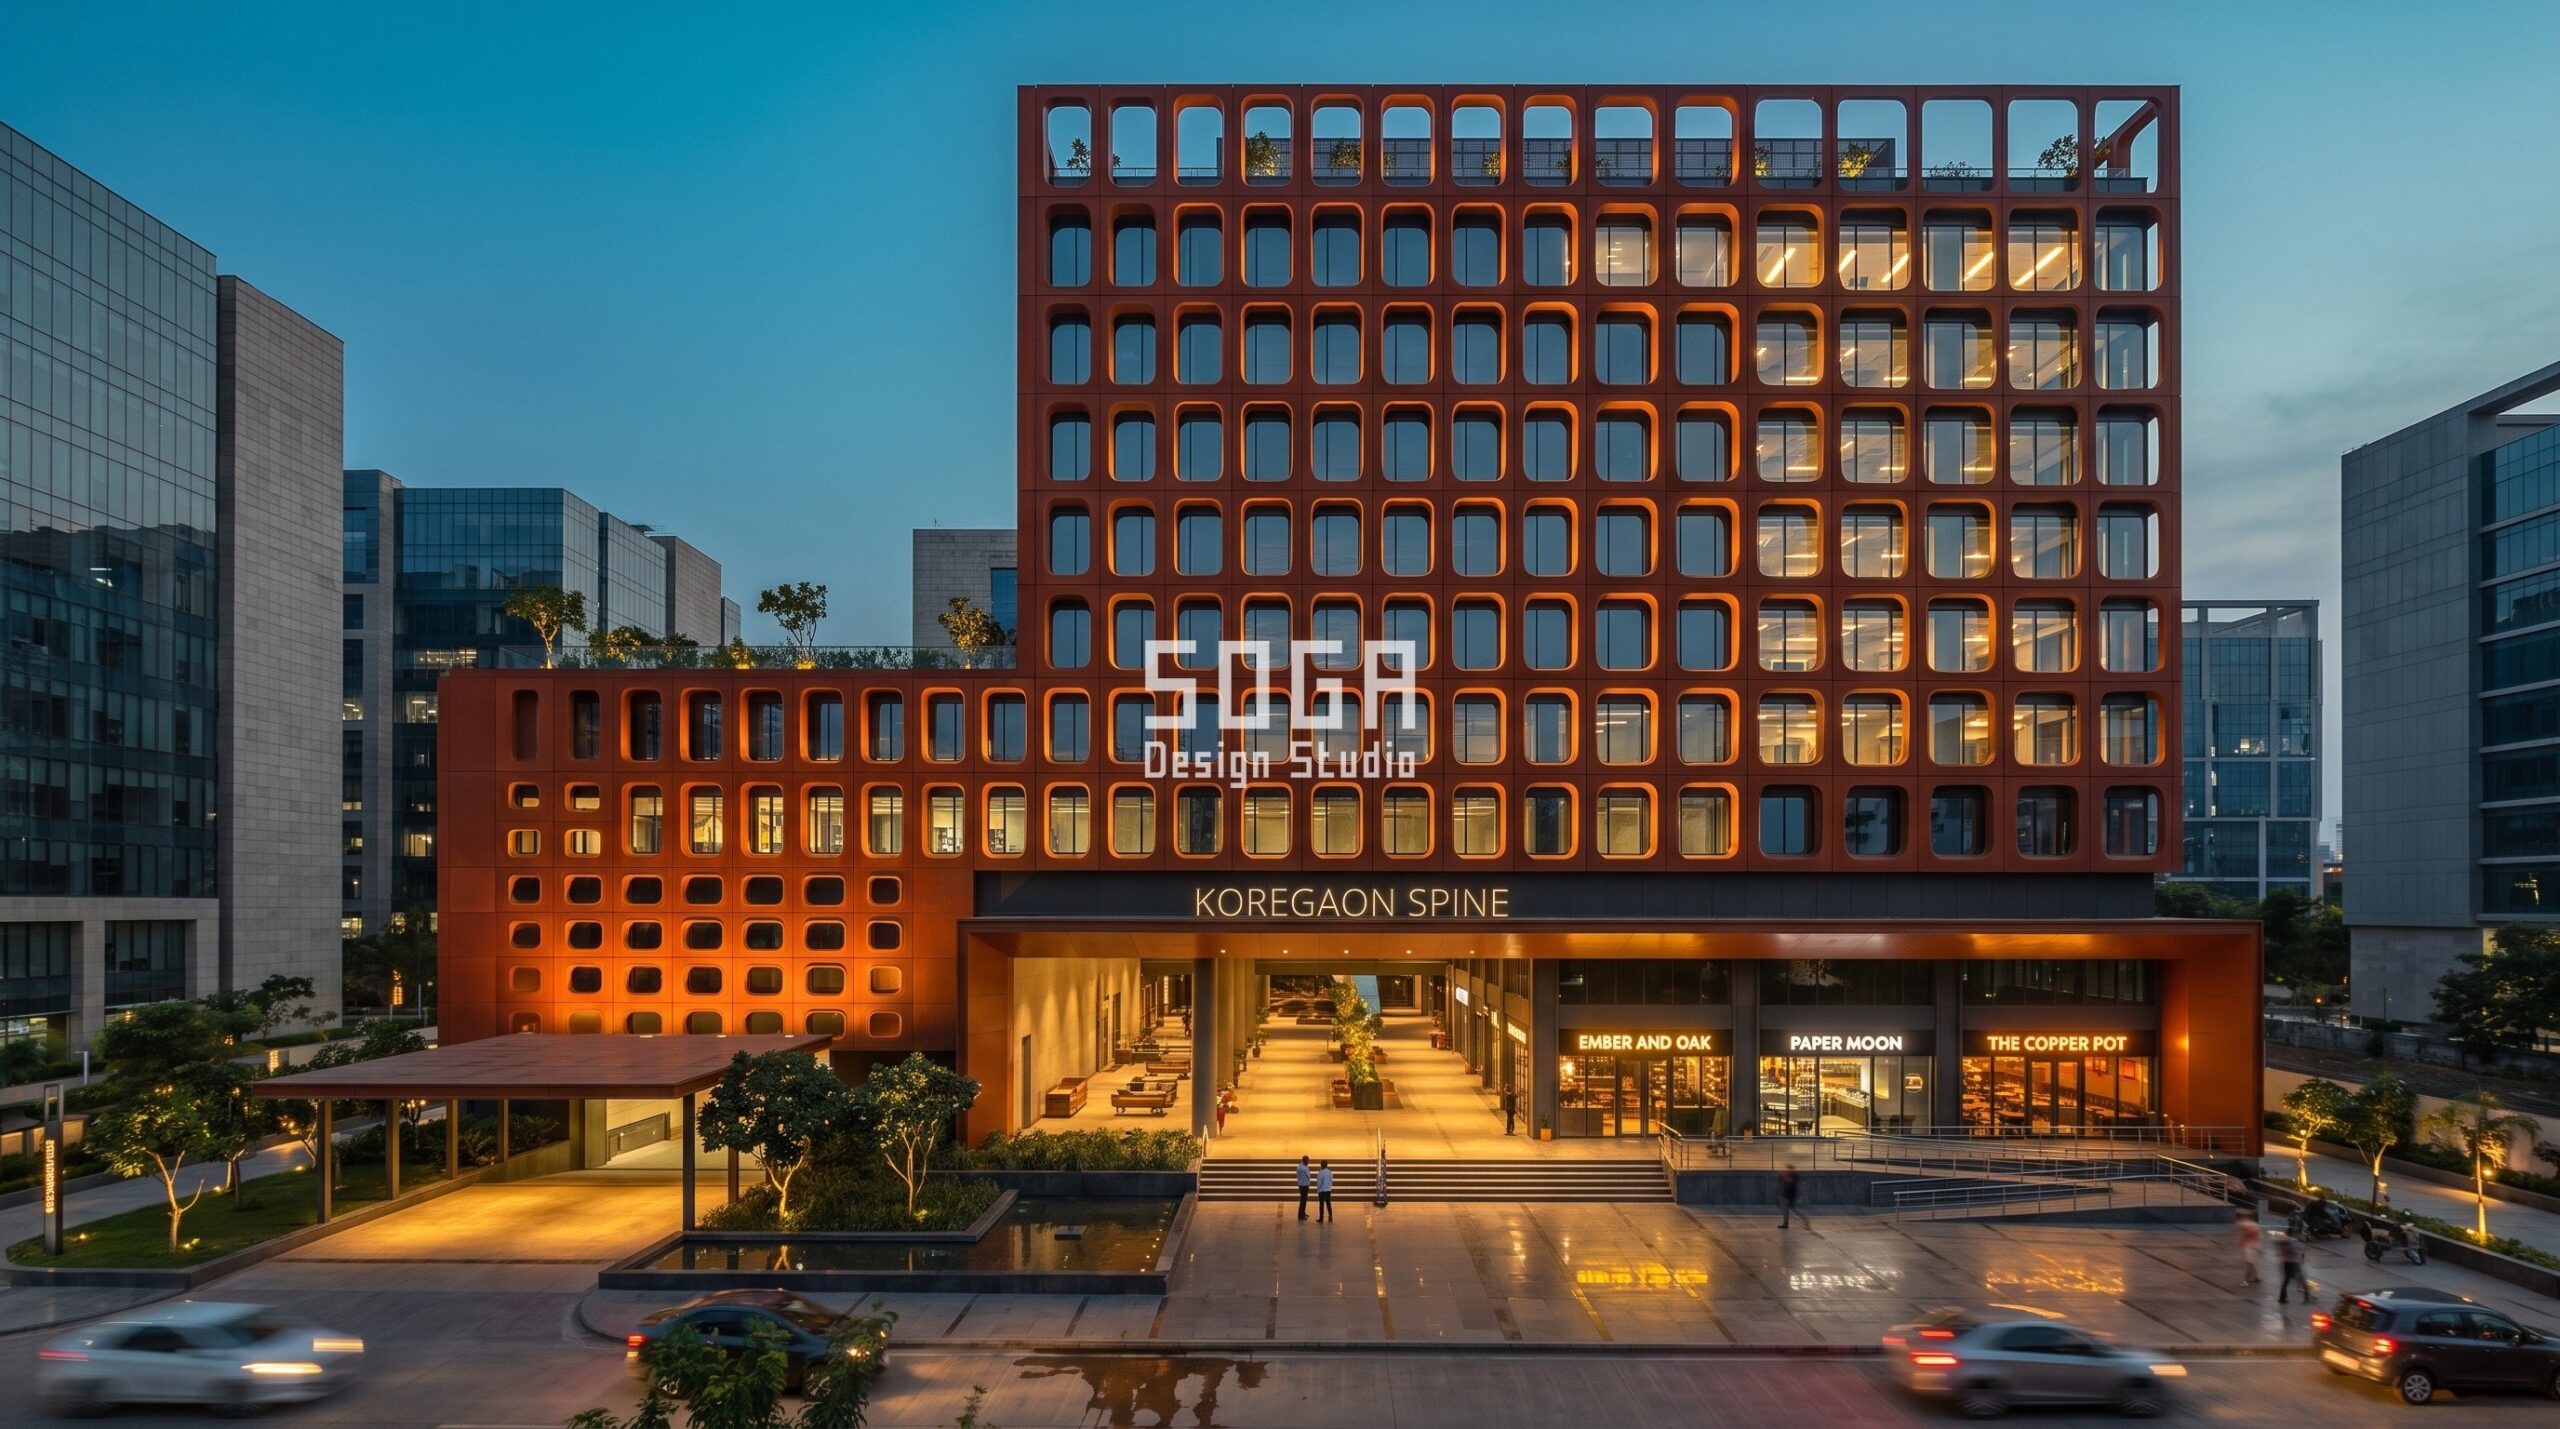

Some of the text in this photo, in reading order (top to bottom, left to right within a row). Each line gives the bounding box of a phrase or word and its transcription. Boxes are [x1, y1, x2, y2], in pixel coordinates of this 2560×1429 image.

[1196, 888, 1509, 917] KOREGAON SPINE
[1579, 1035, 1711, 1050] EMBER AND OAK
[1790, 1036, 1902, 1051] PAPER MOON
[1987, 1036, 2127, 1051] THE COPPER POT
